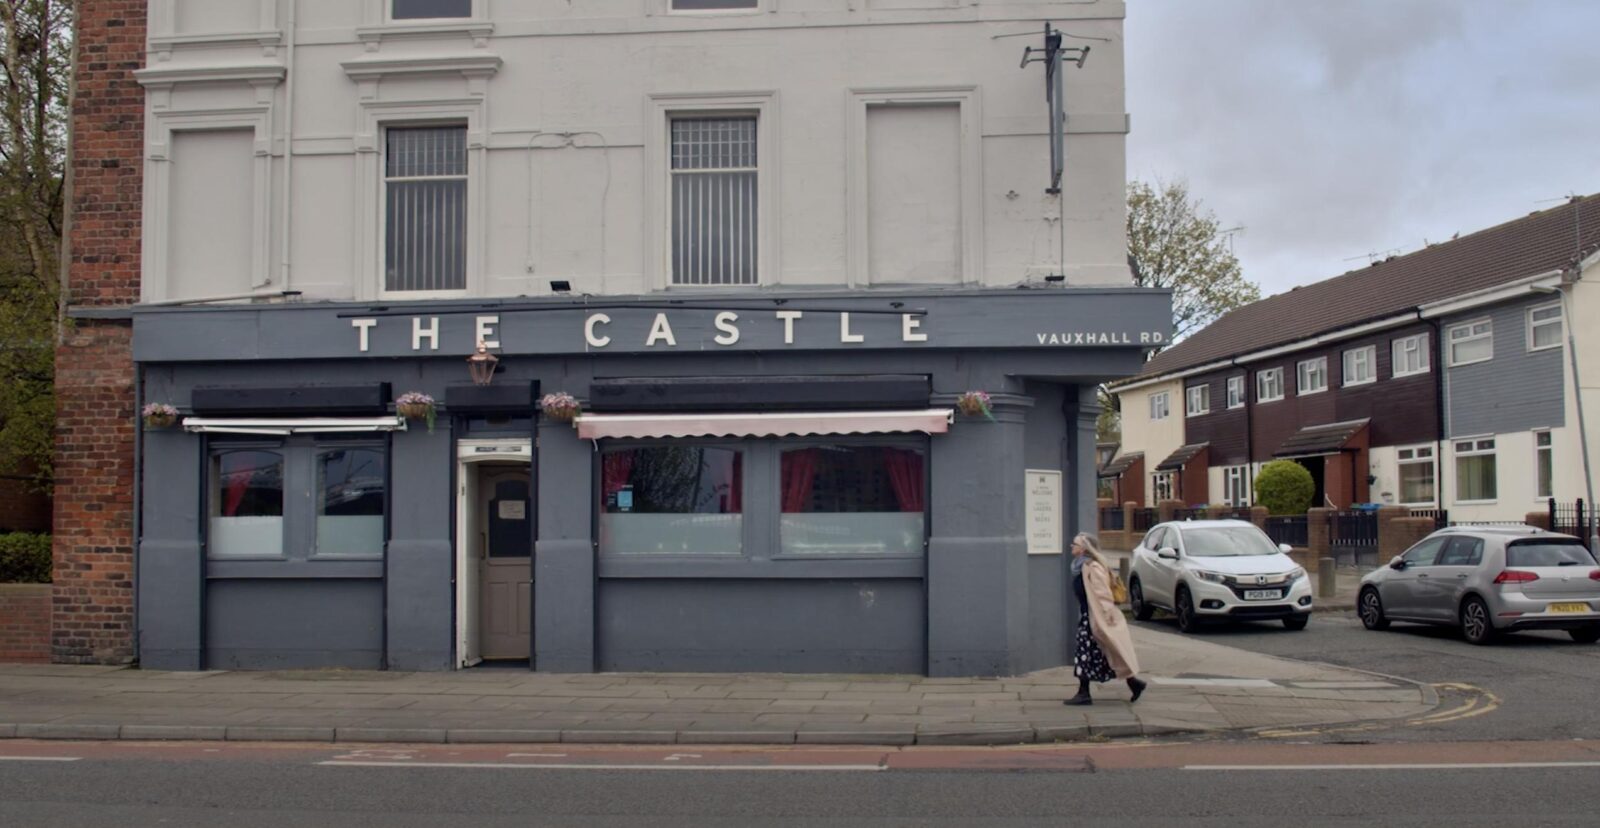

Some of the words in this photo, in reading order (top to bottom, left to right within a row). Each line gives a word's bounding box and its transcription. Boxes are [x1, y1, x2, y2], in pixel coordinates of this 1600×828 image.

[352, 316, 500, 351] THE
[584, 309, 928, 348] CASTLE
[1036, 332, 1131, 345] VAUXHALL
[1139, 331, 1170, 344] RD.
